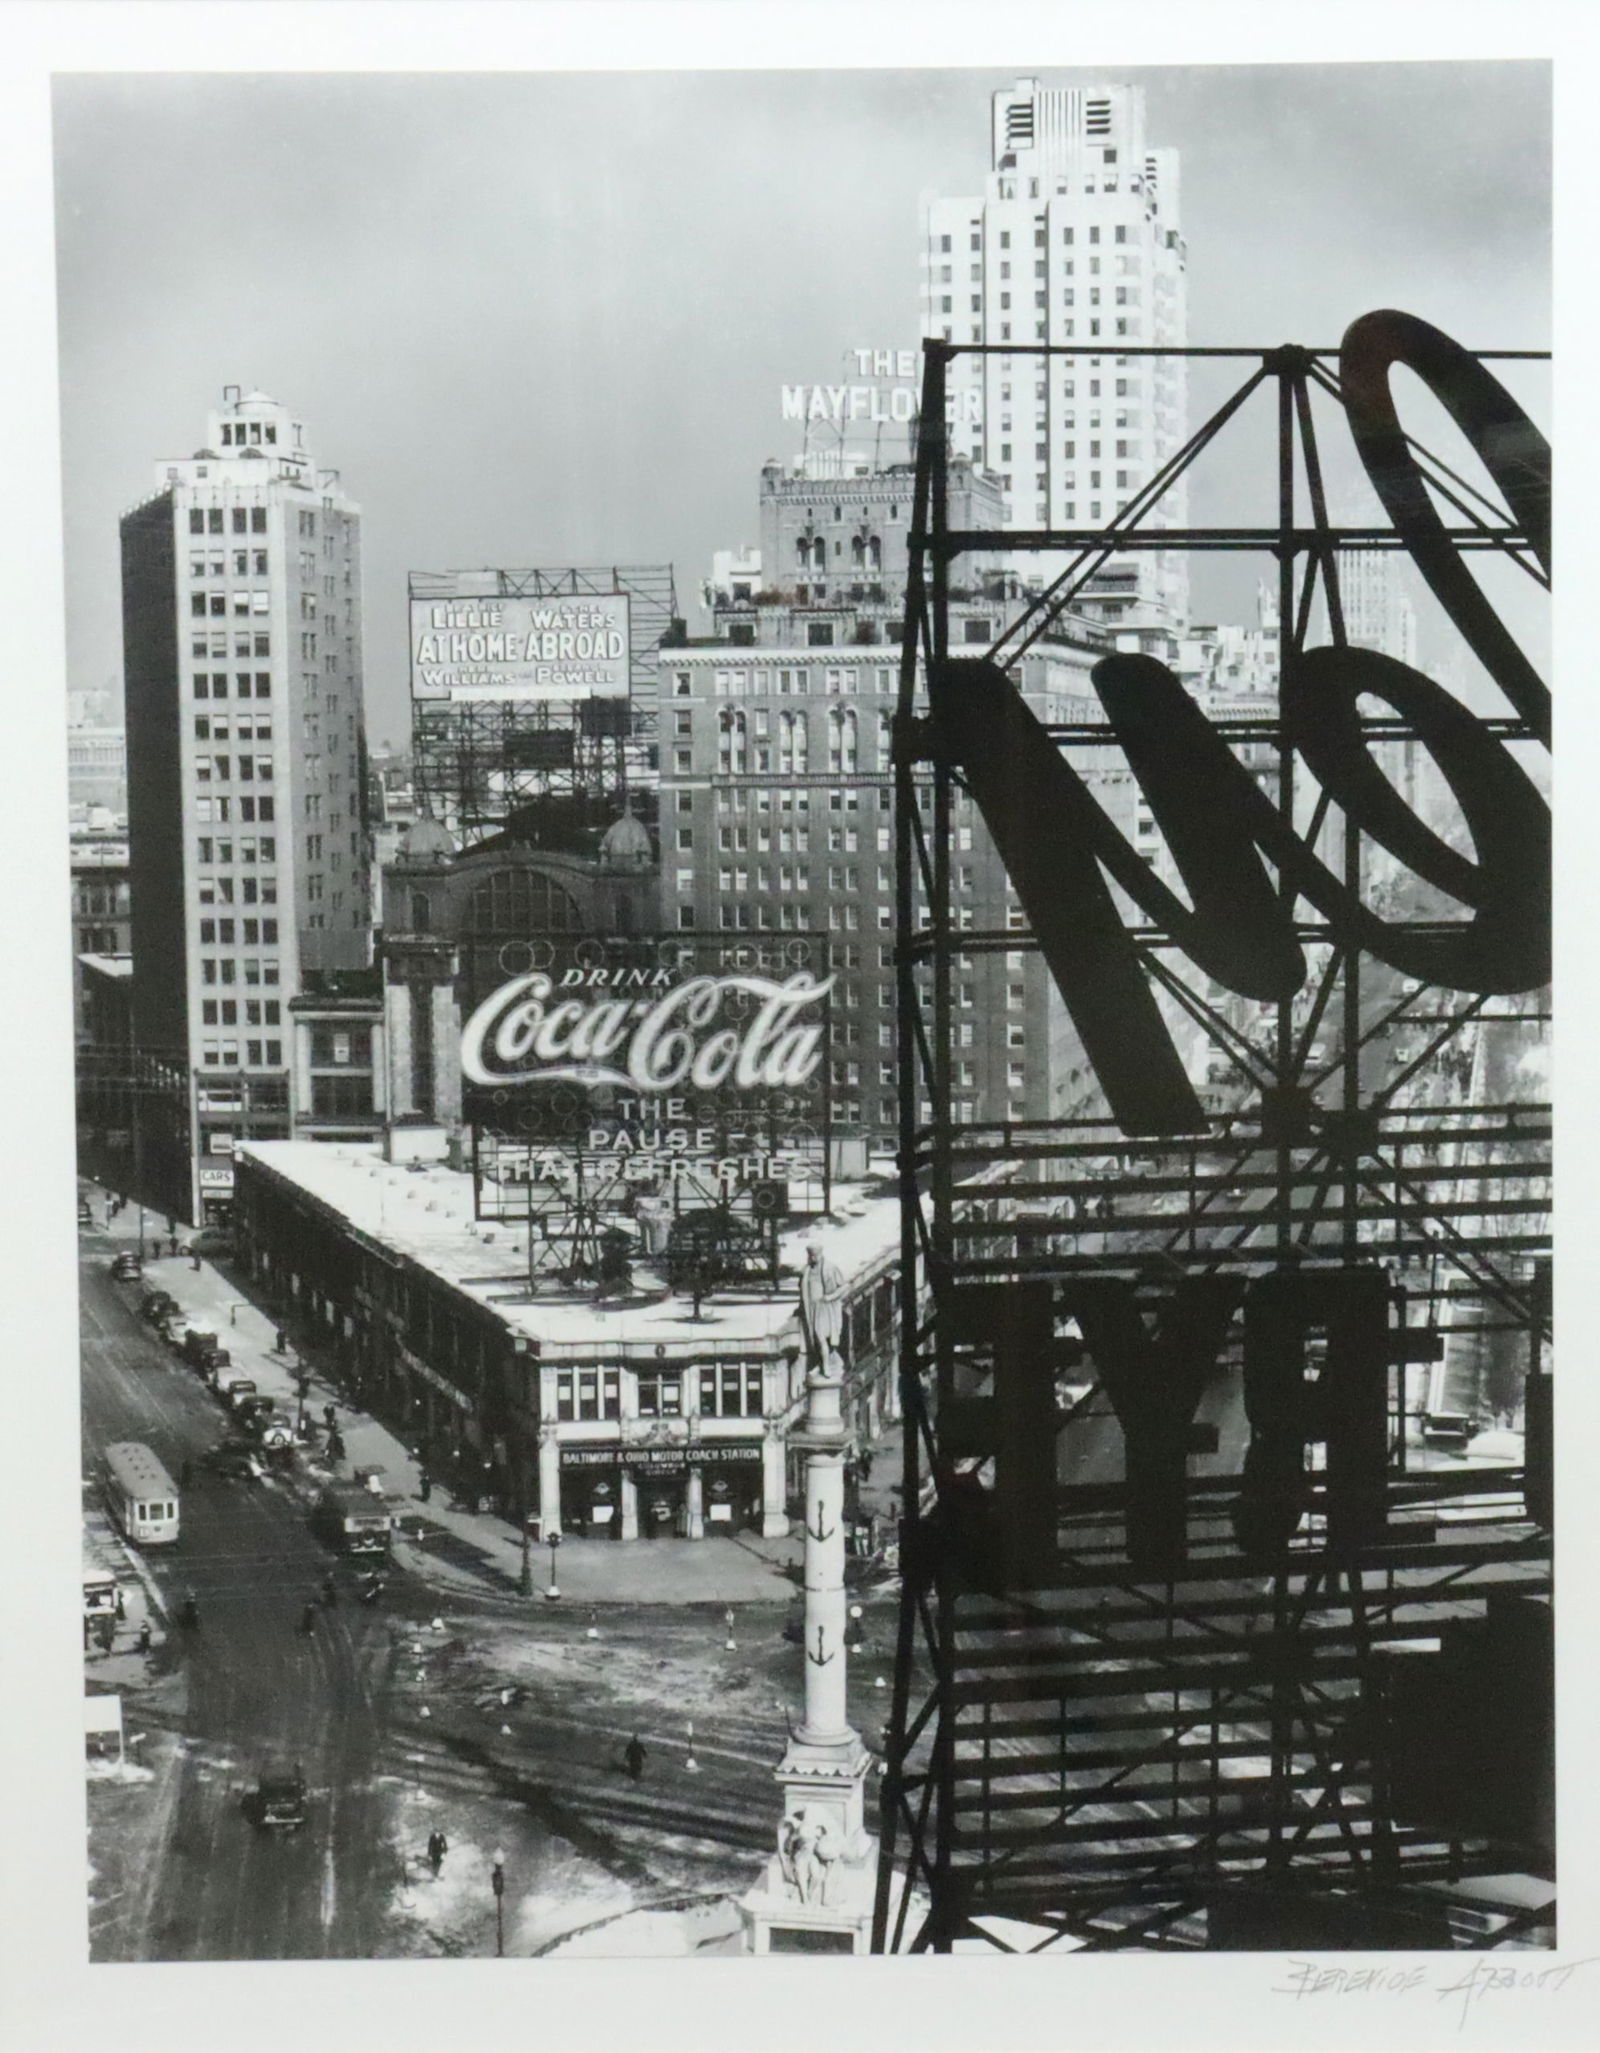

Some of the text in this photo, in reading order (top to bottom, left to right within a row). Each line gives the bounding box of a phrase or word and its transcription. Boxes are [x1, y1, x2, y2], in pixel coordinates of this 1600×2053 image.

[854, 349, 916, 377] THE
[782, 384, 984, 423] MAYFLOER
[432, 607, 502, 629] LILLIE
[531, 609, 616, 630] WATERS
[417, 631, 625, 664] AT HOME ABROAD
[422, 669, 517, 686] WILLIAMS
[536, 666, 615, 685] POWELL
[559, 968, 678, 988] DRINK
[461, 971, 837, 1092] Coca-Cola
[618, 1098, 688, 1121] THE
[588, 1128, 716, 1151] PAUSE
[202, 1171, 231, 1182] CARS
[599, 1157, 812, 1181] REFRESHES
[563, 1452, 615, 1465] BALTIMORE
[625, 1451, 650, 1463] OHIO
[651, 1450, 684, 1463] MOTOR
[686, 1449, 719, 1462] COACH
[721, 1448, 760, 1461] STATION
